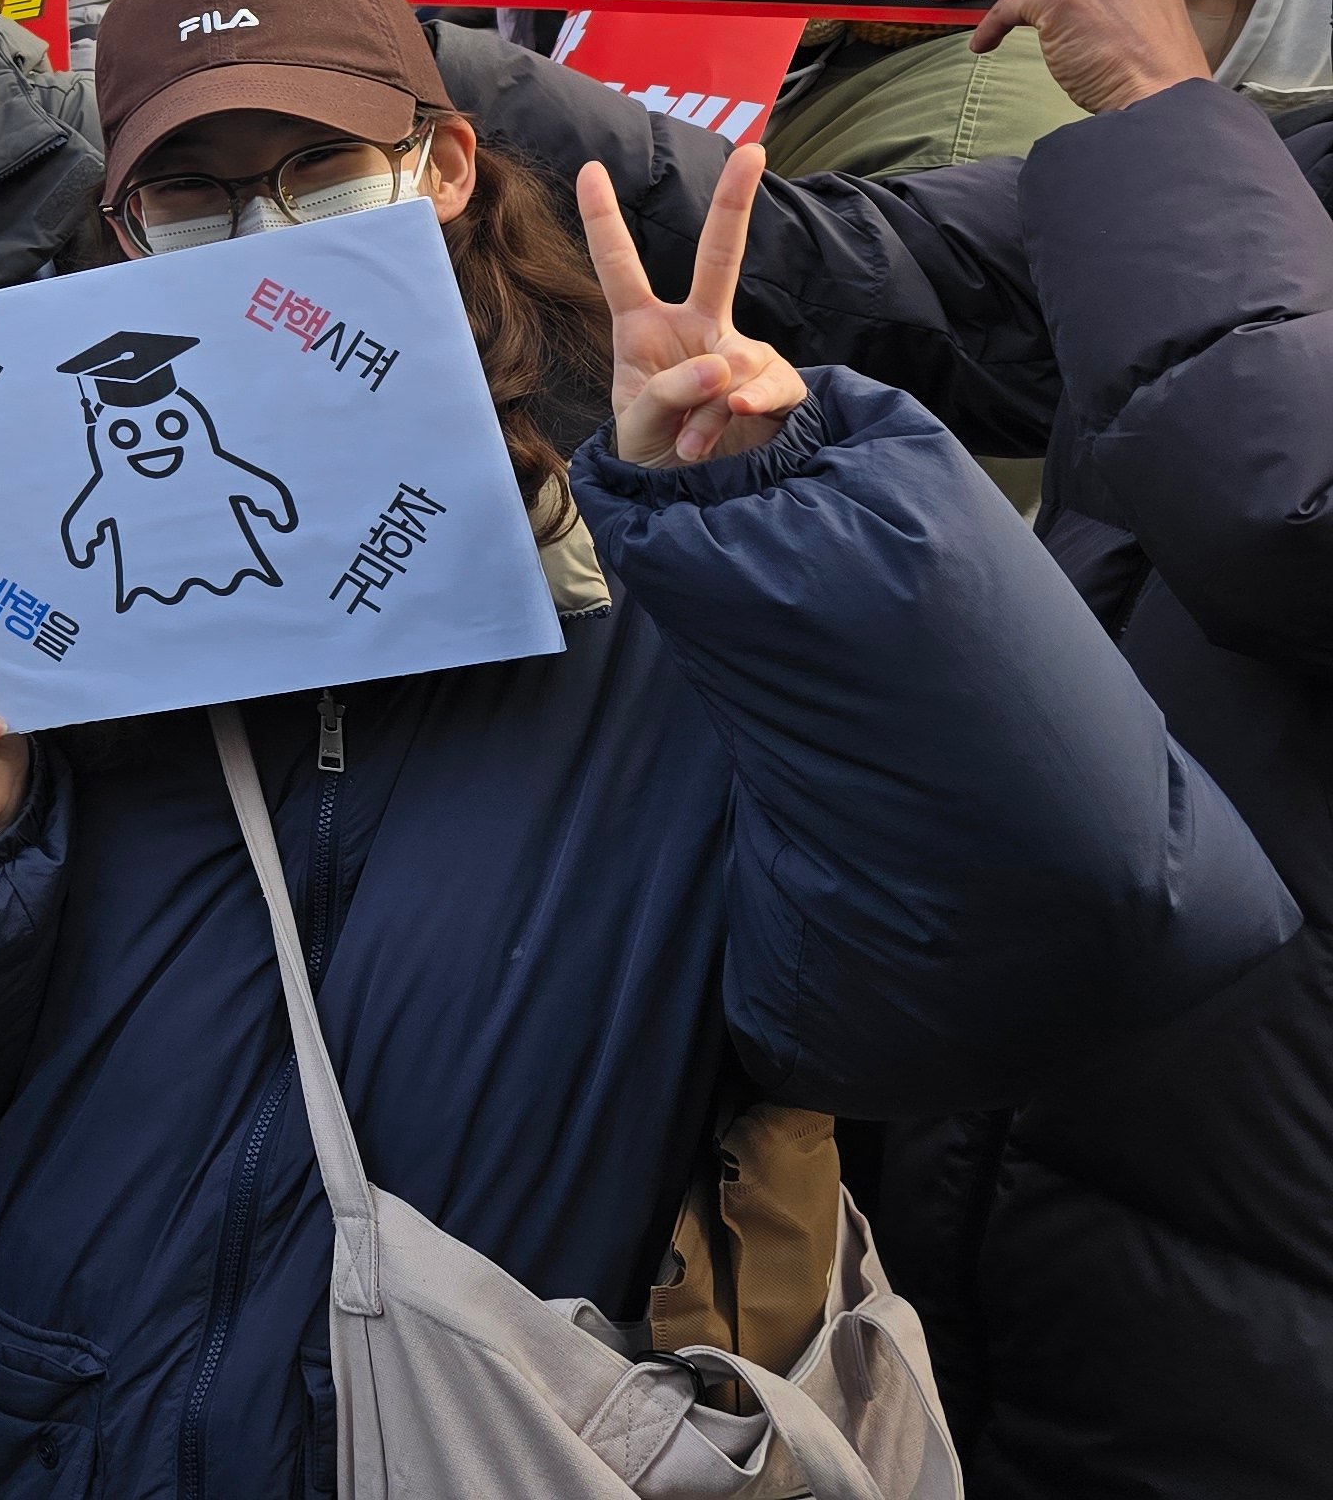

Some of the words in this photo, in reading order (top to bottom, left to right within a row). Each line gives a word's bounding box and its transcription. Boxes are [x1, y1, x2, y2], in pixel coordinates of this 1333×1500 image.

[178, 8, 261, 42] FILA
[244, 277, 401, 393] 탄핵시켜
[329, 481, 448, 615] 구마하자
